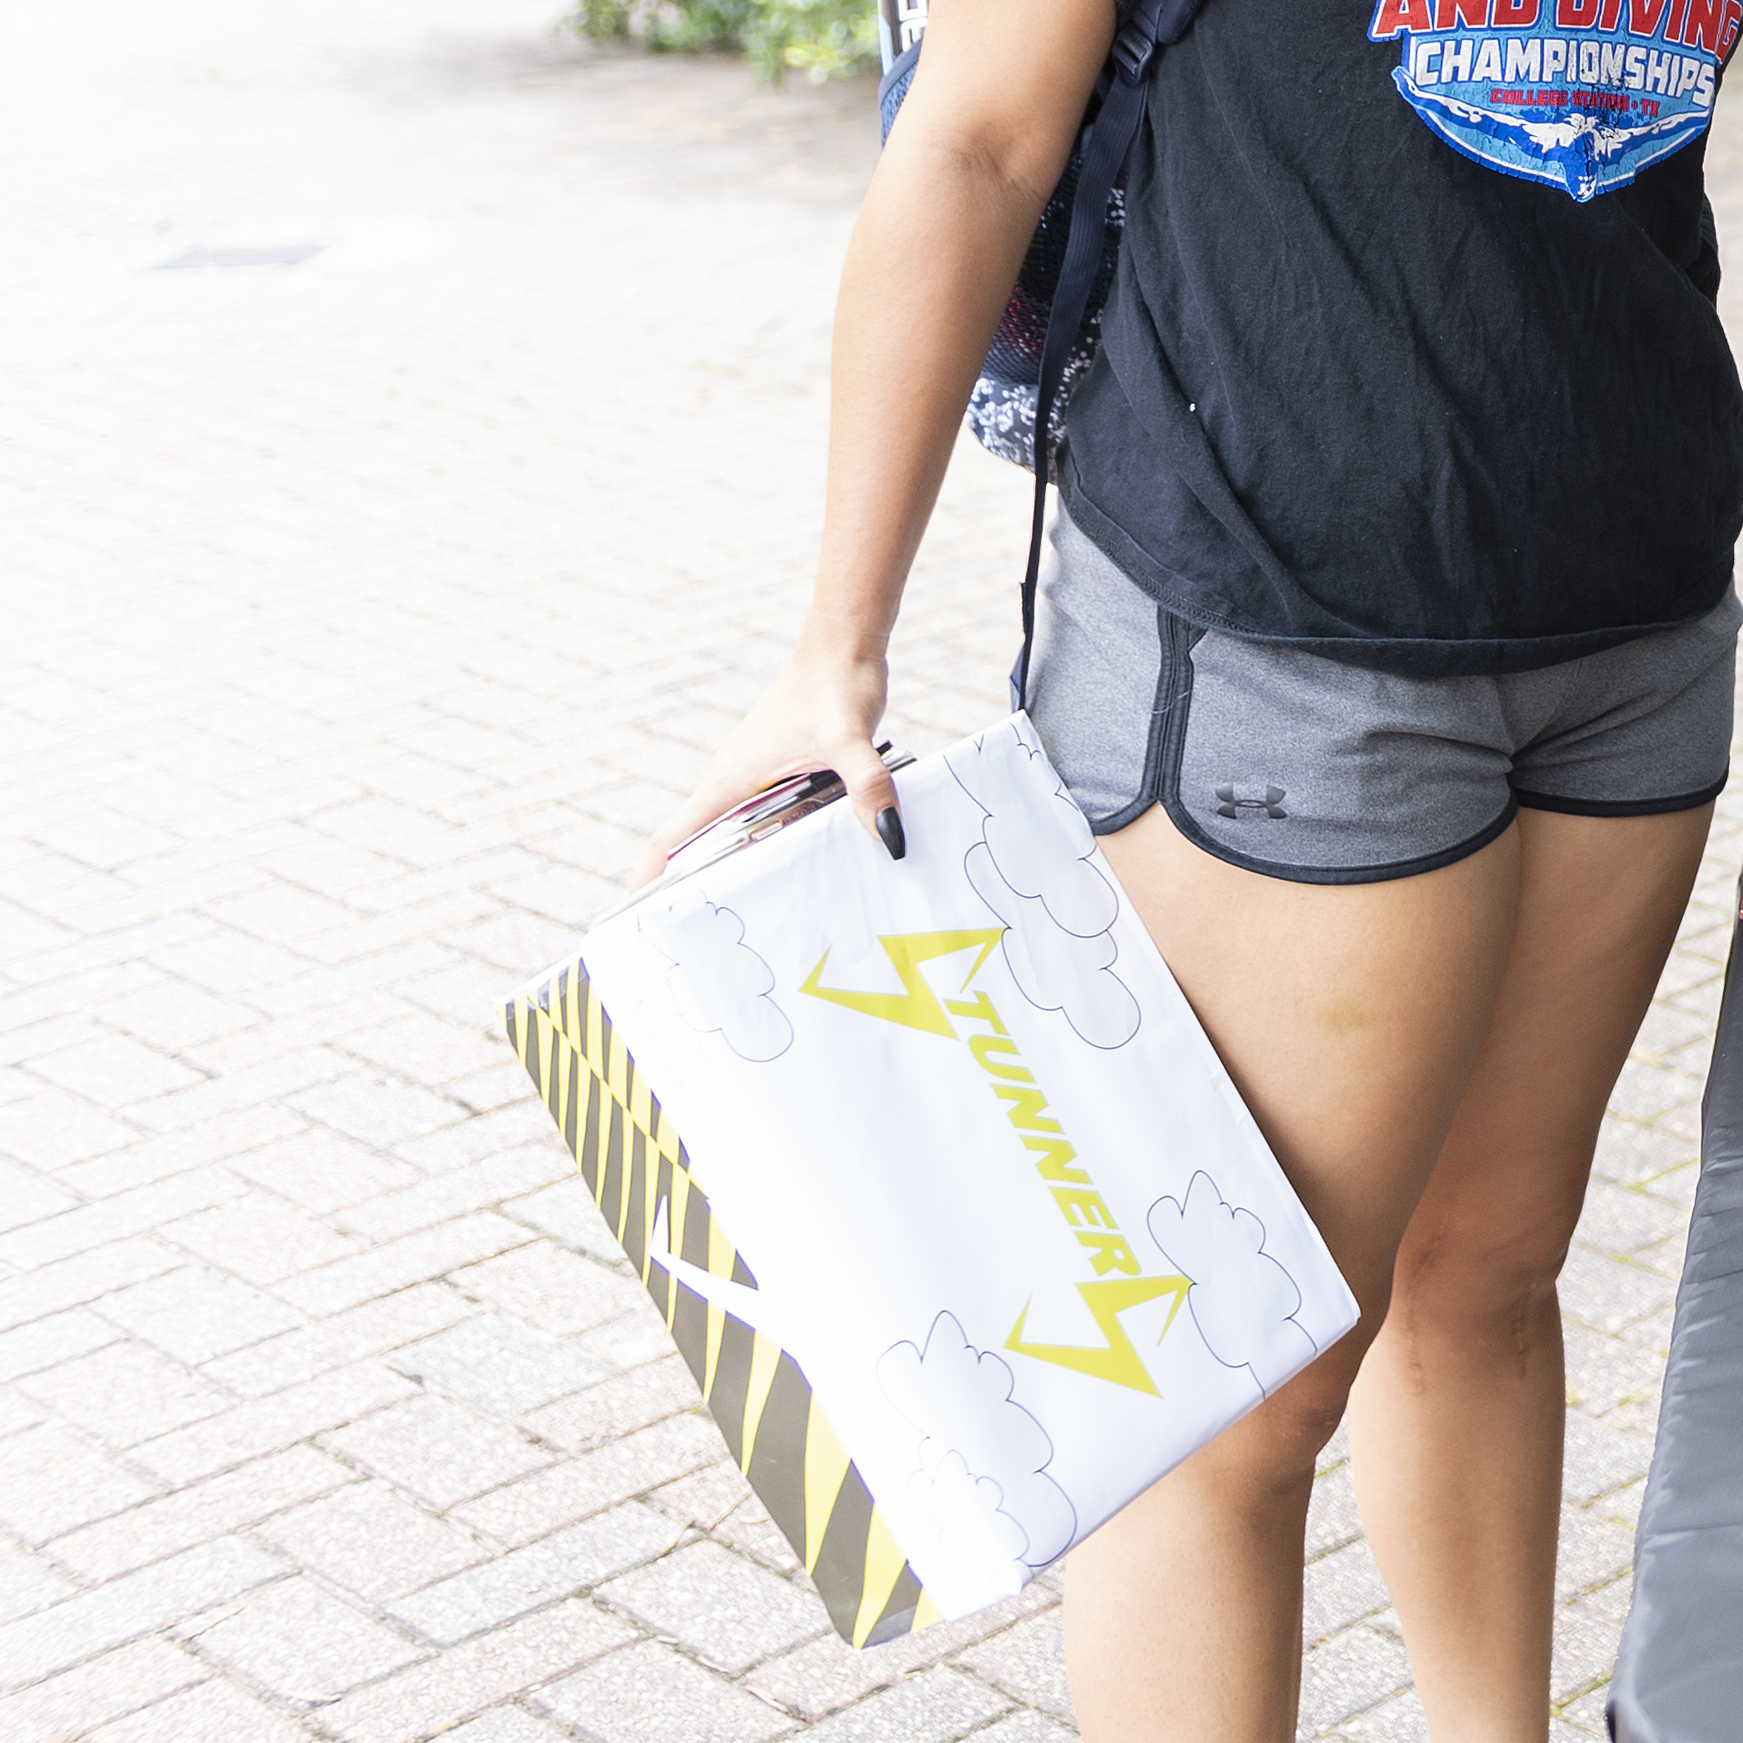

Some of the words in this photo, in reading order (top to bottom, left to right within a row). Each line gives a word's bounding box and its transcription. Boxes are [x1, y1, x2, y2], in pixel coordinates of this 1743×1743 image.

[1415, 39, 1715, 106] CHAMPIONSHIPS
[1490, 89, 1568, 106] COLLEGE
[1572, 90, 1629, 112] STATION
[1640, 98, 1661, 117] TX
